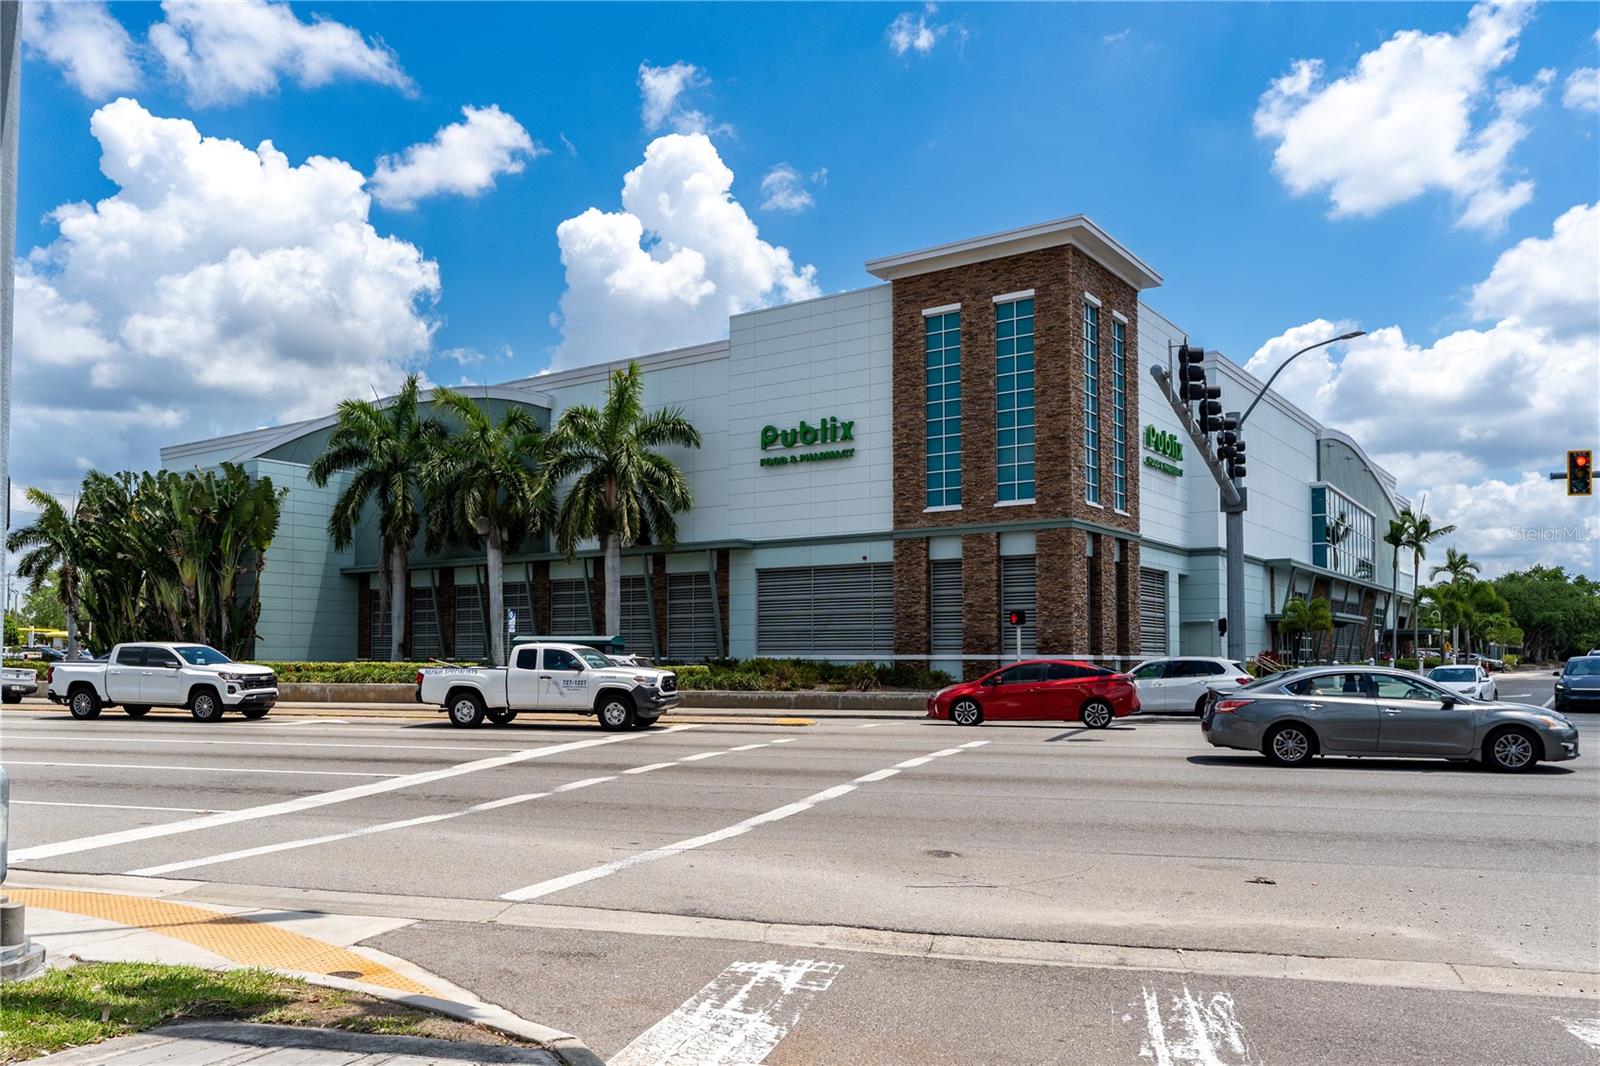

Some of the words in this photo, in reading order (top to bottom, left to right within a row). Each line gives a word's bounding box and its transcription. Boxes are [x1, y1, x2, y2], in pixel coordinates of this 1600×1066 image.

[761, 416, 854, 450] Publix
[1143, 424, 1183, 461] Publix
[760, 456, 788, 466] FOOD
[800, 448, 855, 462] PHARMACY
